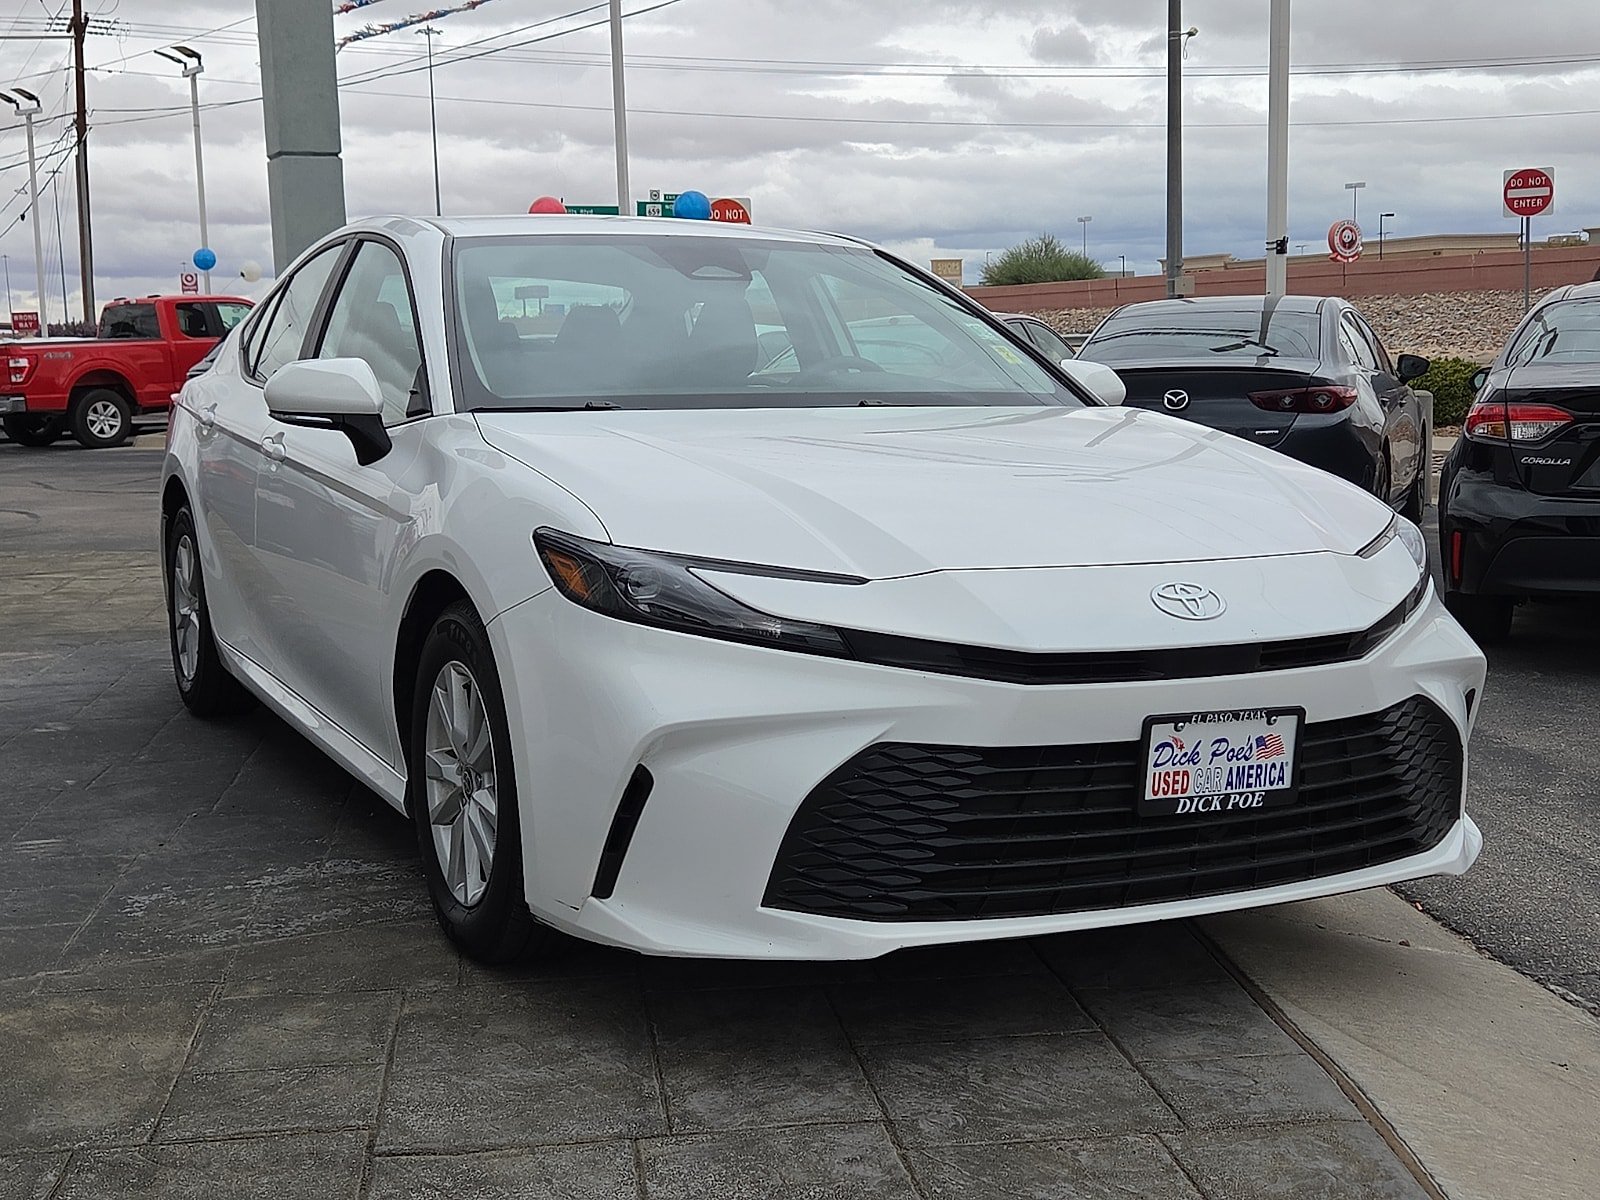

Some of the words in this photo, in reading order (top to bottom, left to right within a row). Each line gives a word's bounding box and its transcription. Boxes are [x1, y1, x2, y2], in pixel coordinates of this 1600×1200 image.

[1510, 178, 1523, 188] DO
[1528, 176, 1547, 186] NOT
[1513, 198, 1543, 208] ENTER
[647, 207, 660, 216] 659
[725, 209, 744, 220] NOT
[1520, 456, 1571, 465] COROLLA
[1191, 714, 1202, 725] EL
[1239, 709, 1268, 722] TEXAS
[1153, 739, 1202, 769] Dick
[1208, 734, 1255, 766] Poe's
[1151, 769, 1191, 797] USED
[1193, 766, 1223, 794] CAR
[1174, 794, 1226, 814] DICK
[1226, 791, 1266, 811] POE
